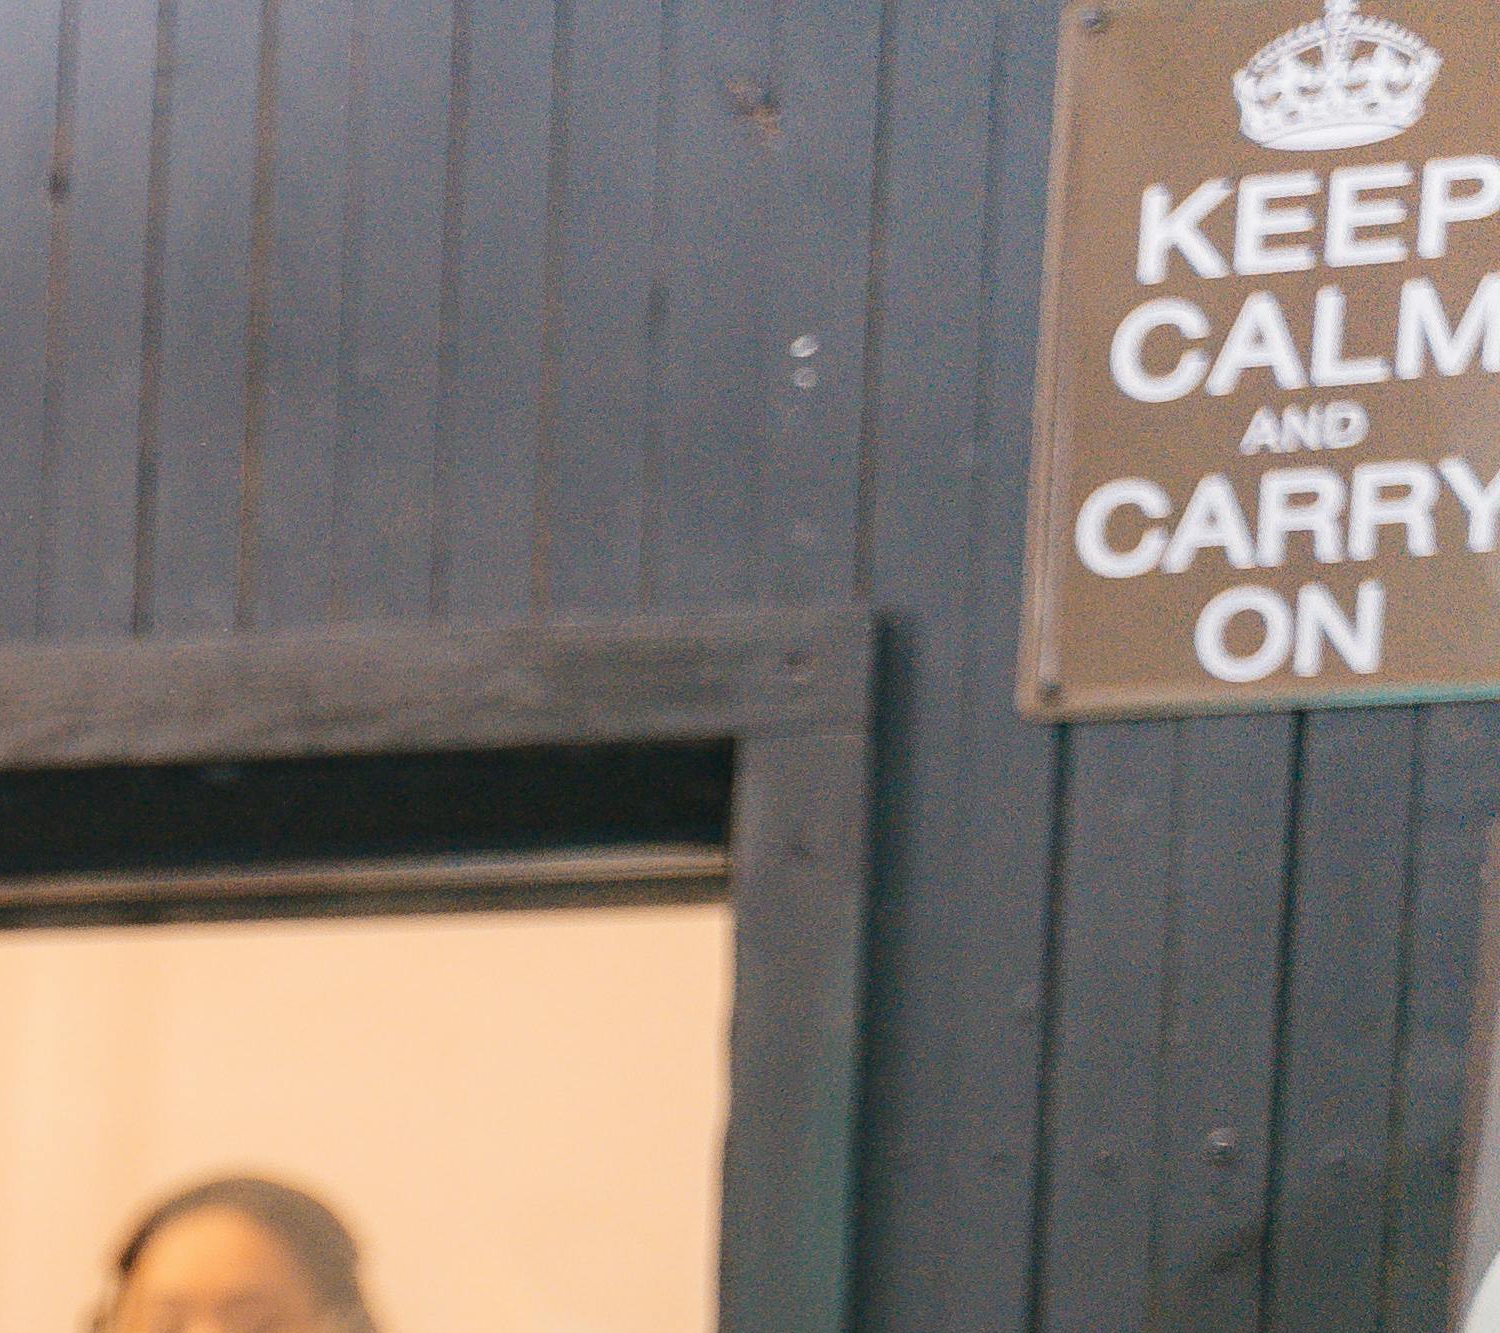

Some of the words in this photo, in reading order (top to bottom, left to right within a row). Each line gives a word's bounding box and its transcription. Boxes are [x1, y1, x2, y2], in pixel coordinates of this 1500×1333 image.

[1137, 155, 1500, 286] KEEP
[1110, 271, 1500, 403] CALM
[1240, 402, 1369, 455] AND
[1075, 457, 1500, 578] CARRY
[1193, 579, 1385, 682] ON
